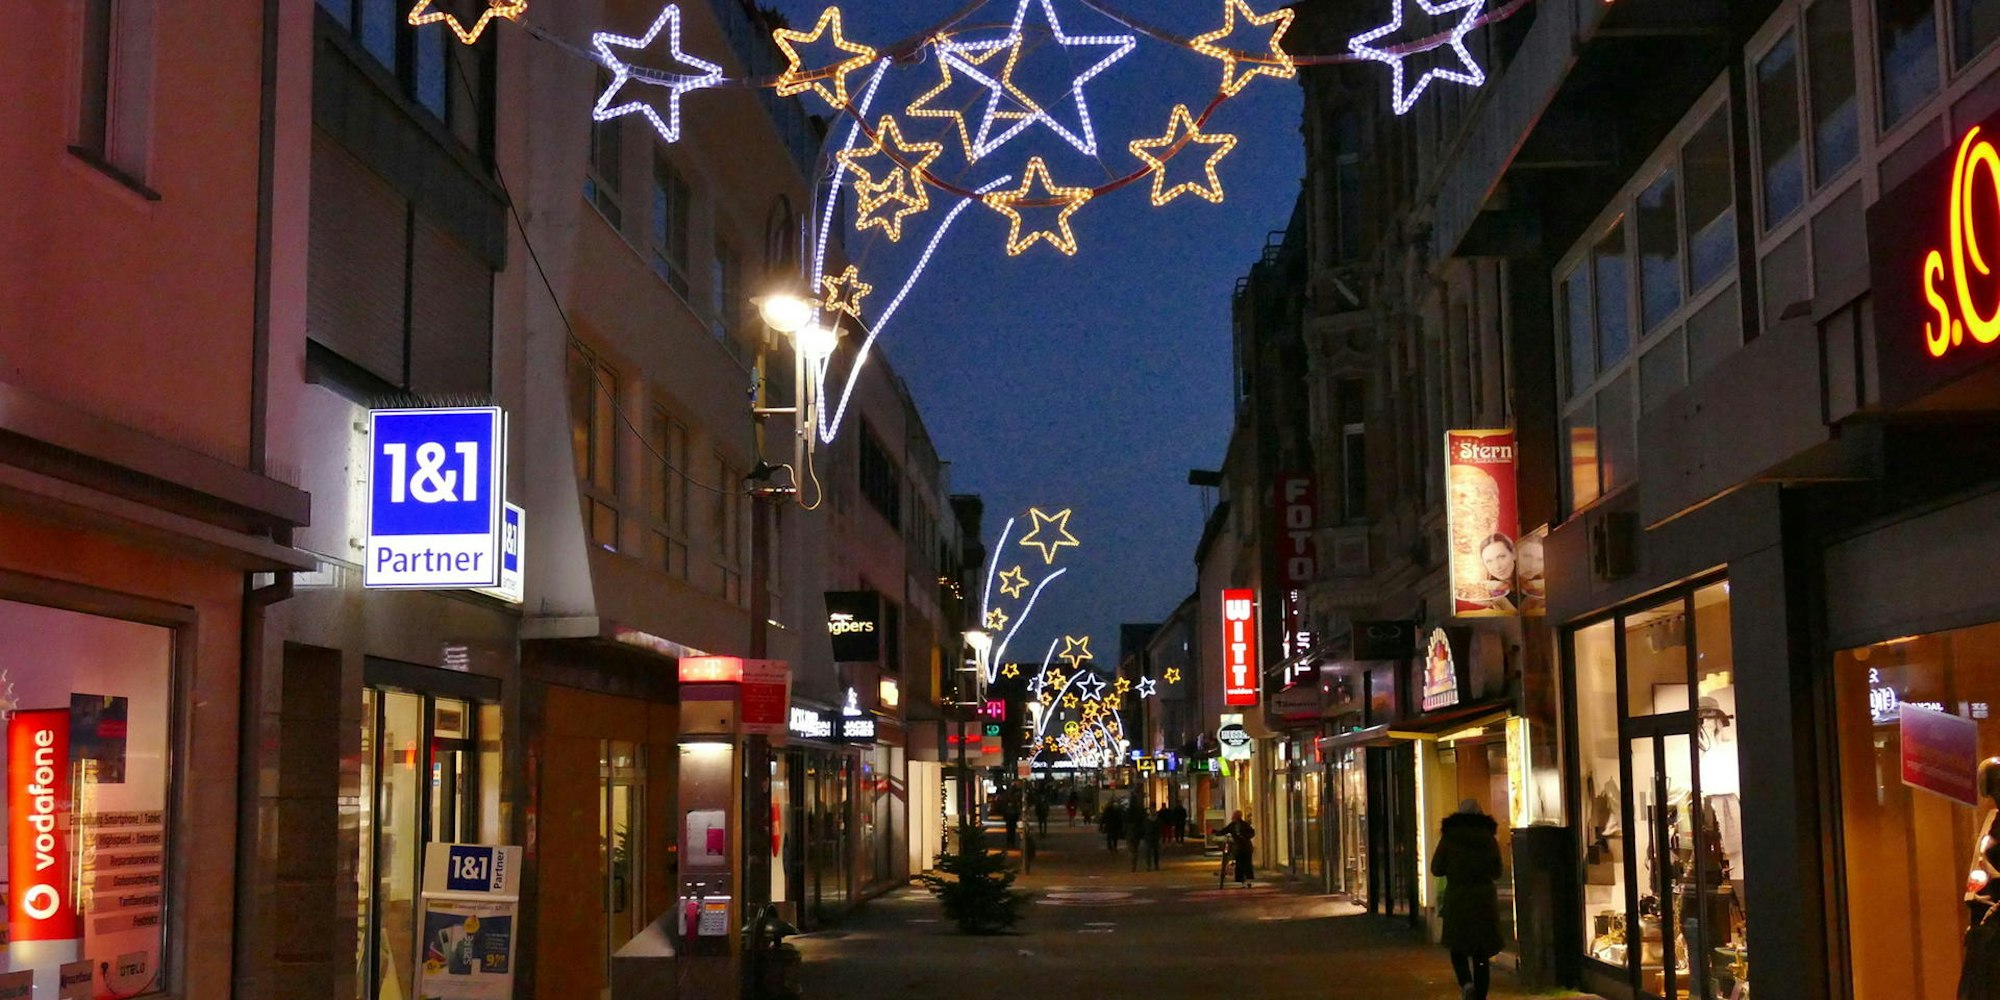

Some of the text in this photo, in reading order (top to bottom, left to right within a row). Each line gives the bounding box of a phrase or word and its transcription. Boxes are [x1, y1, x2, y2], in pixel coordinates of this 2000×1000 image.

[1460, 442, 1512, 459] Stern
[383, 441, 478, 503] 1&1
[1284, 478, 1315, 581] FOTO
[376, 547, 484, 573] Partner
[1226, 599, 1251, 687] WITT
[843, 728, 874, 737] JONES
[28, 729, 55, 871] vodafone
[452, 856, 488, 880] 1&1
[494, 849, 505, 889] Partner
